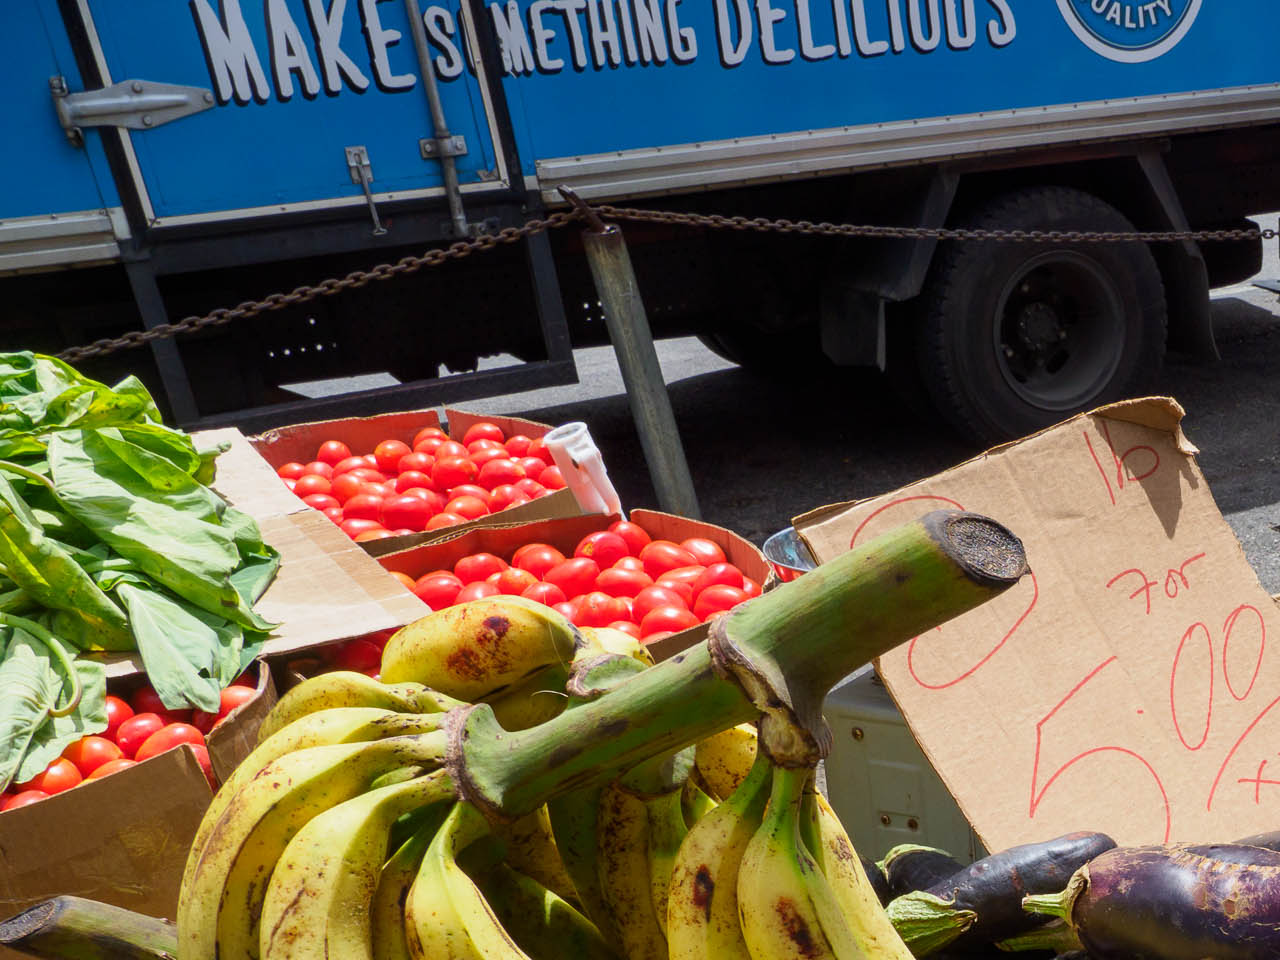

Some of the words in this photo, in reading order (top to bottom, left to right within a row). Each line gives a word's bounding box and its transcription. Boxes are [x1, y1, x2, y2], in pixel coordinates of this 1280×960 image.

[193, 0, 418, 106] MAKE
[423, 0, 699, 81] SMETHING
[1090, 0, 1172, 29] UALITY
[1083, 419, 1160, 505] lb
